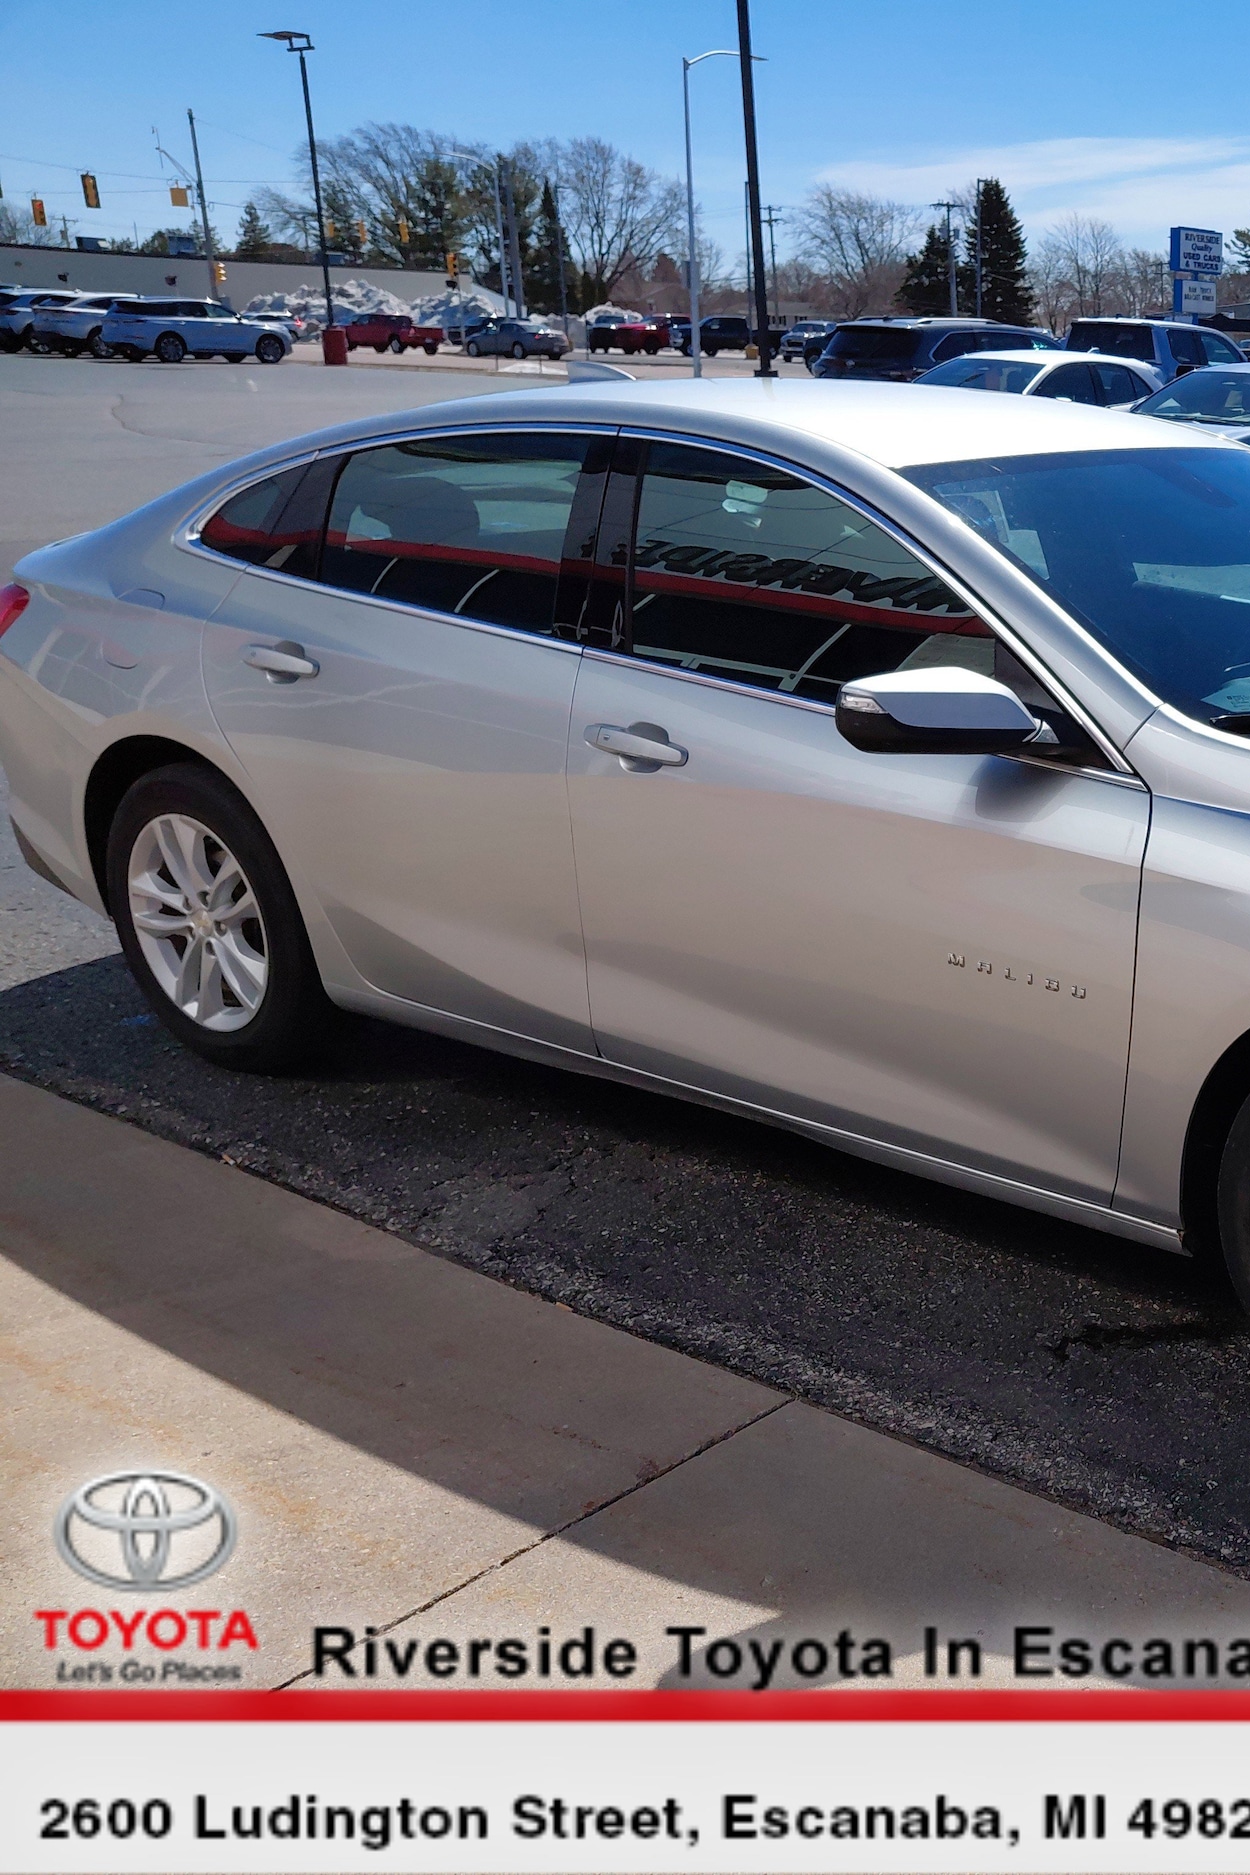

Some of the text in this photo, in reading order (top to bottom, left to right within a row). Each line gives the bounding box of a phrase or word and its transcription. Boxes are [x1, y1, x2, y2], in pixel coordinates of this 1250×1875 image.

[1185, 233, 1220, 245] RIVERSIDE
[1191, 243, 1213, 254] Quality
[1183, 252, 1221, 263] USED CARS
[1193, 262, 1219, 271] TRUCKS
[947, 953, 1086, 999] MALIBU
